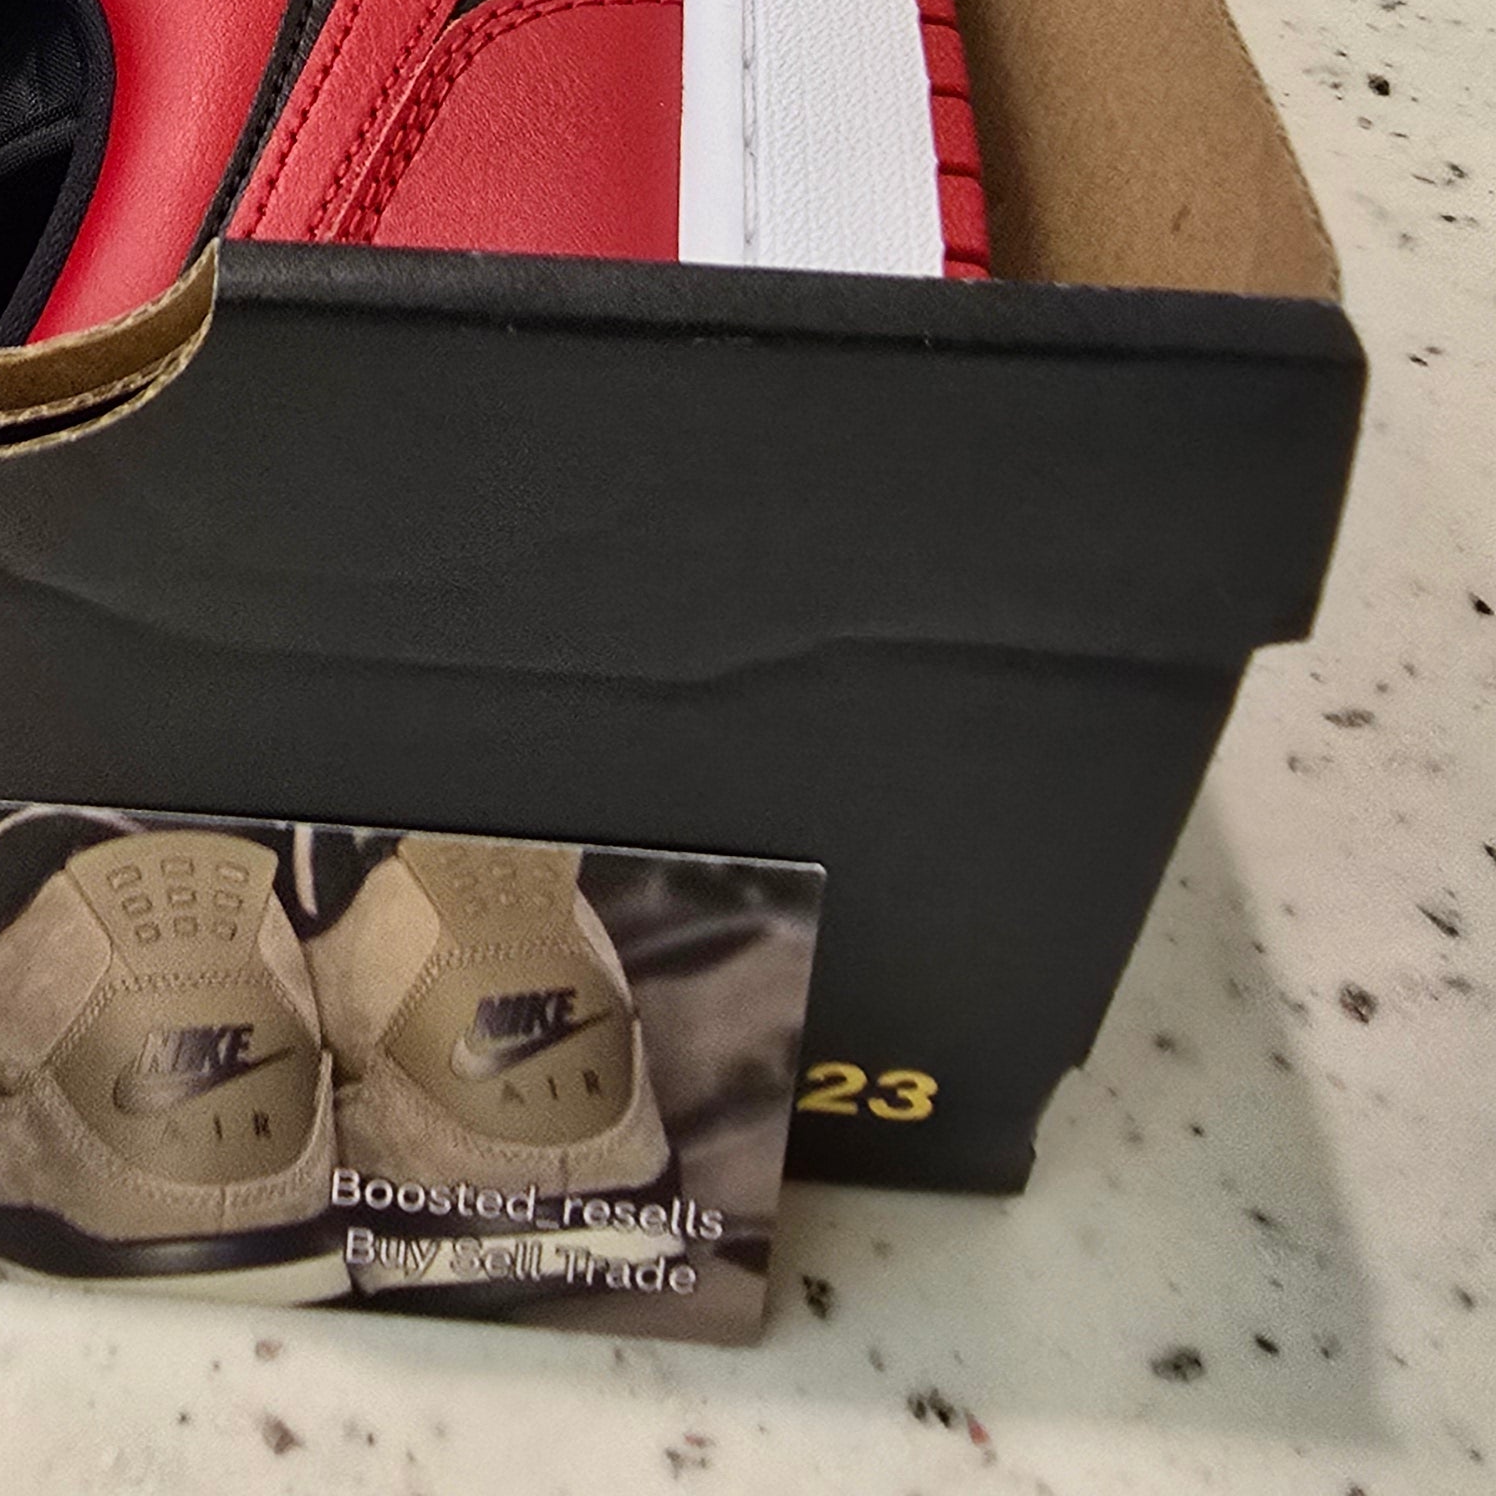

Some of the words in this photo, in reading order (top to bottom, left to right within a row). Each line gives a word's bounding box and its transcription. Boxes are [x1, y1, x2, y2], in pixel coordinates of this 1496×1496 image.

[474, 986, 577, 1038] NIKE
[132, 1023, 255, 1073] NIKE
[502, 1069, 600, 1105] AIR
[796, 1061, 939, 1121] 23
[331, 1168, 724, 1241] Boosted_resells
[344, 1226, 442, 1282] Buy
[449, 1237, 541, 1282] Sell
[555, 1245, 698, 1295] Trade
